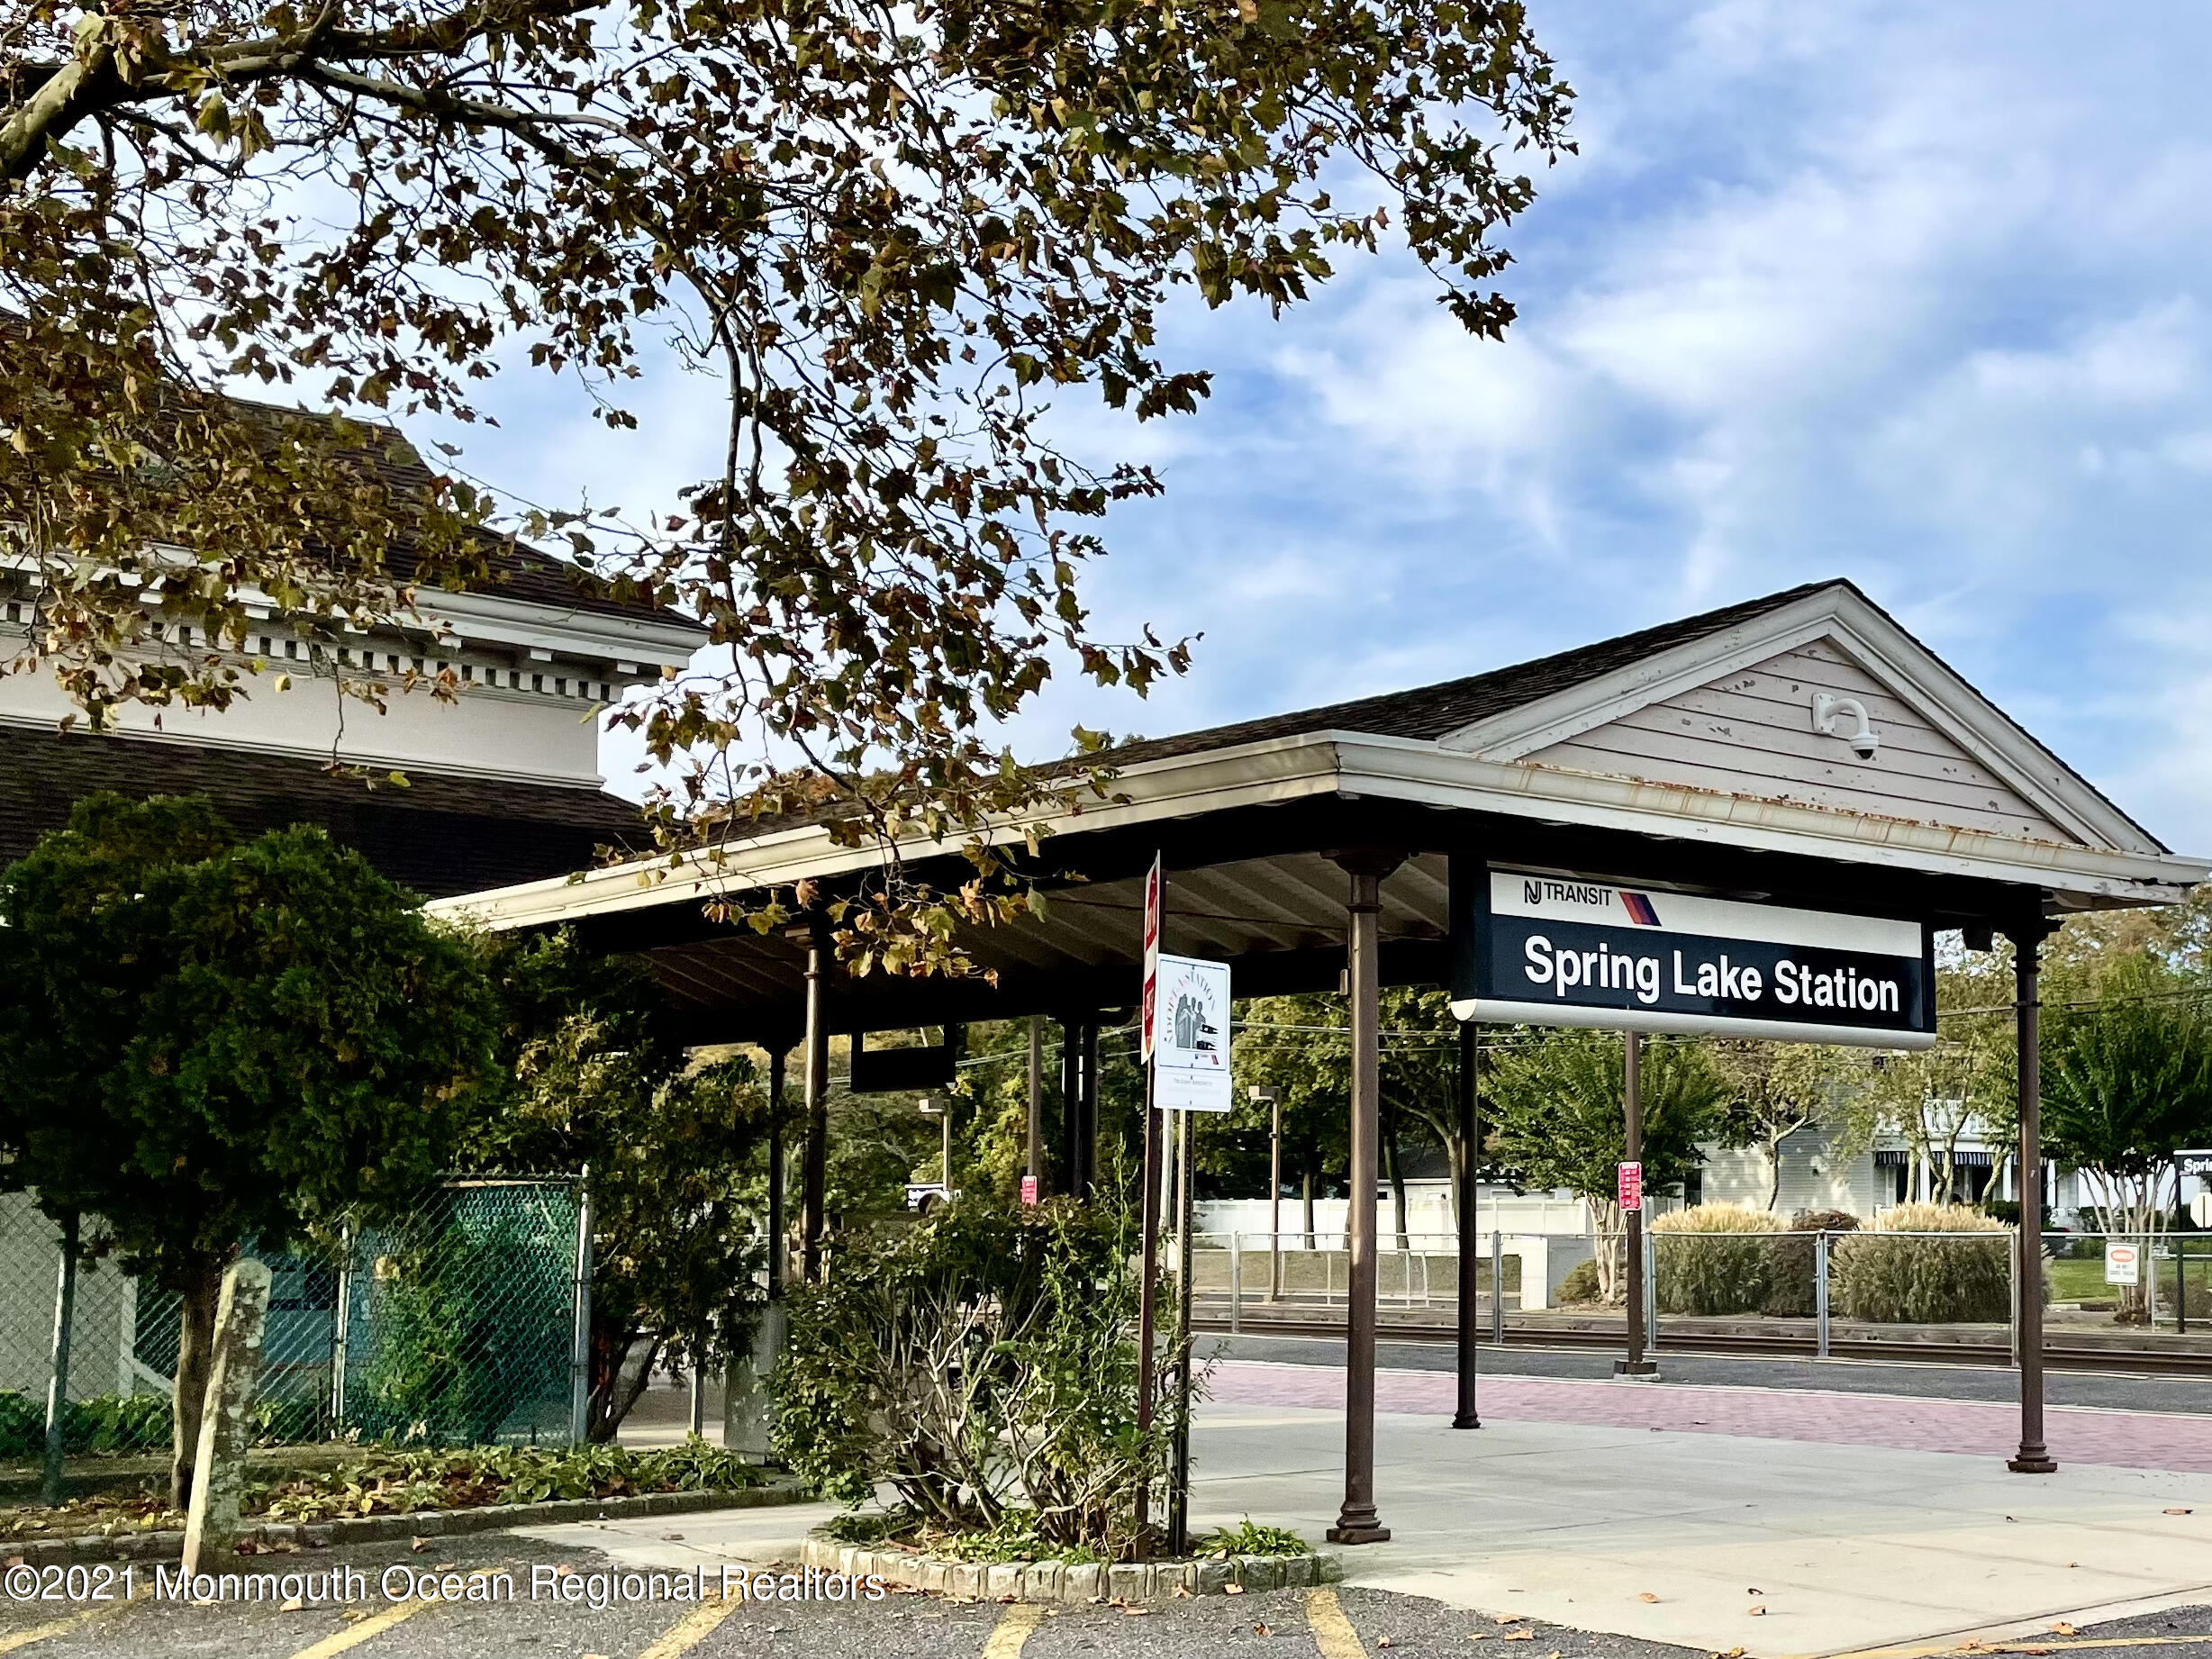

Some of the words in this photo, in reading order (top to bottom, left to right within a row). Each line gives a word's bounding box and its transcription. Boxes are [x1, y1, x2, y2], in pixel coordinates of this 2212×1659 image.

[1544, 882, 1612, 906] TRANSIT
[1524, 935, 1660, 1004] Spring
[1673, 950, 1763, 1002] Lake
[1774, 959, 1899, 1012] Station
